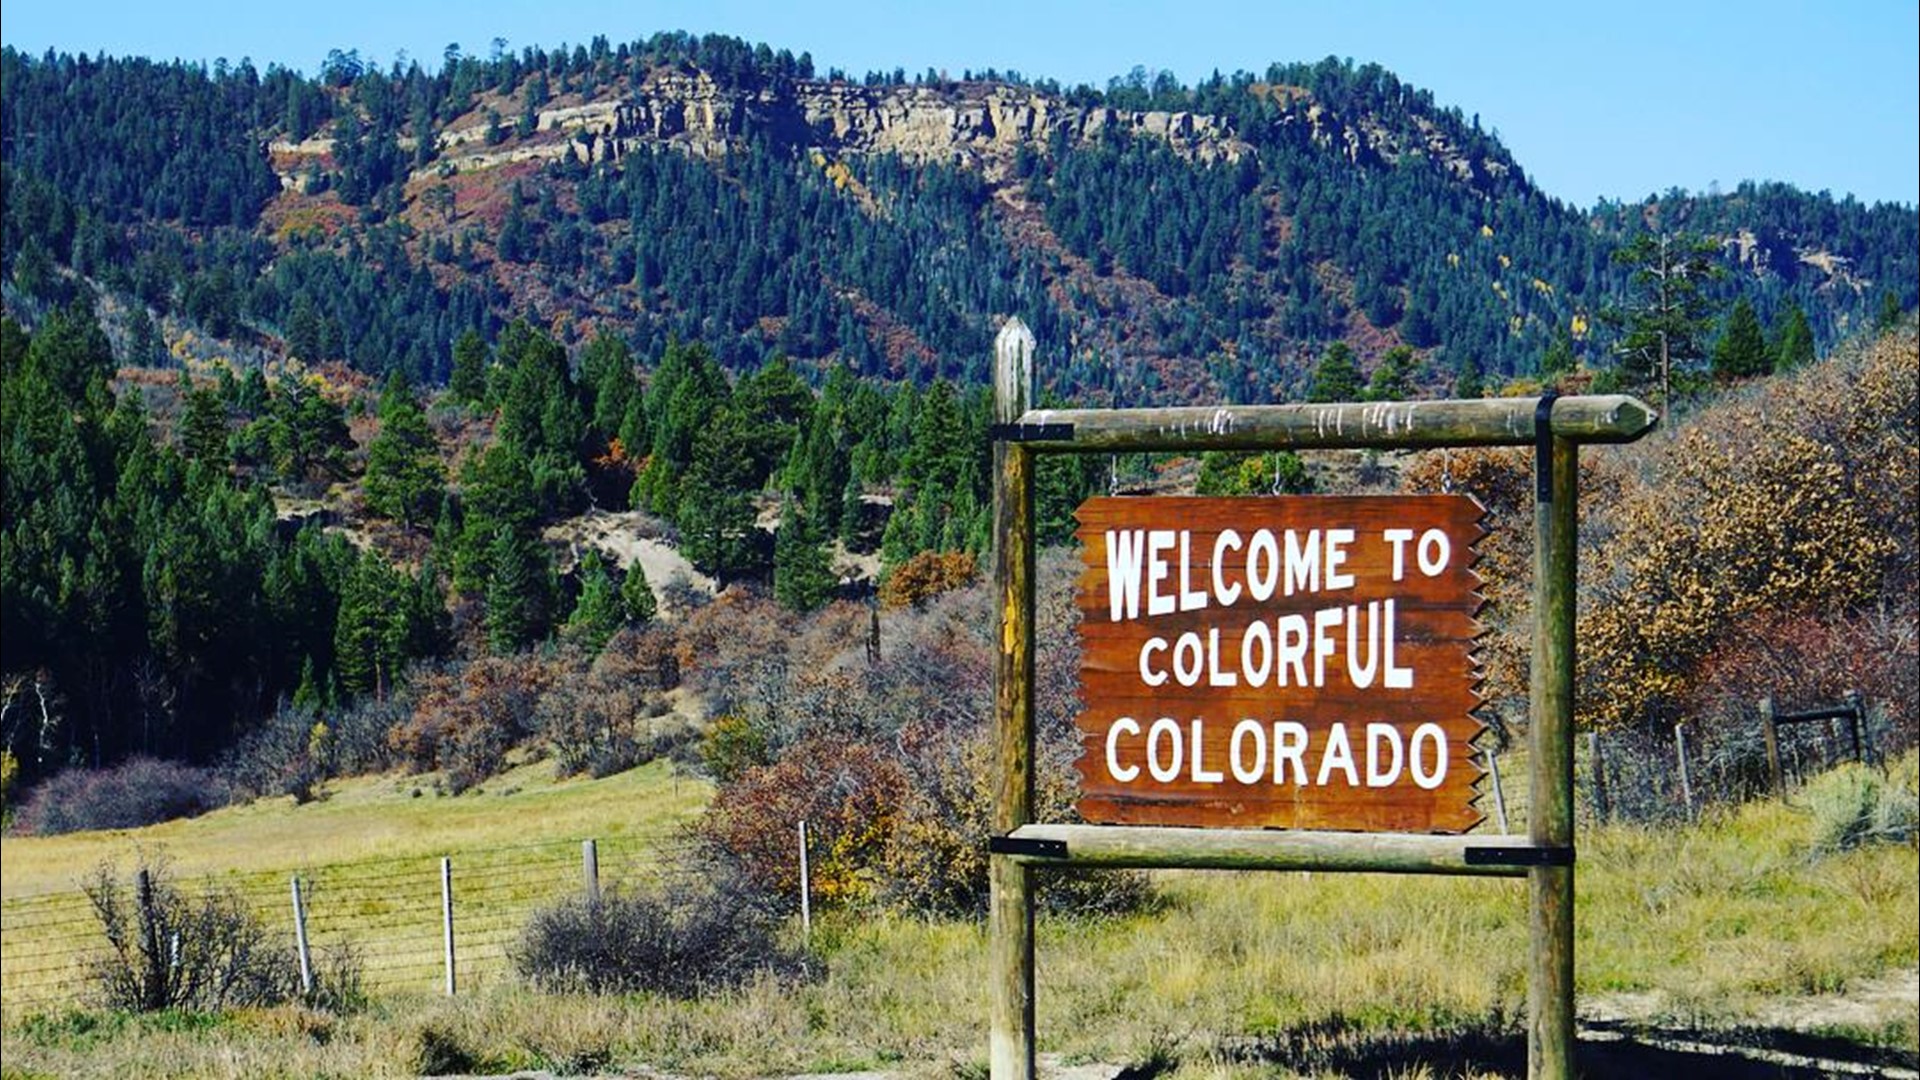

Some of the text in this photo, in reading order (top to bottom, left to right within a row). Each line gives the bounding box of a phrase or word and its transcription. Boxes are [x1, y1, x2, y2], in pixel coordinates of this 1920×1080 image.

[1105, 528, 1451, 622] WELCOME TO
[1139, 598, 1414, 689] COLORFUL
[1105, 717, 1449, 789] COLORADO
